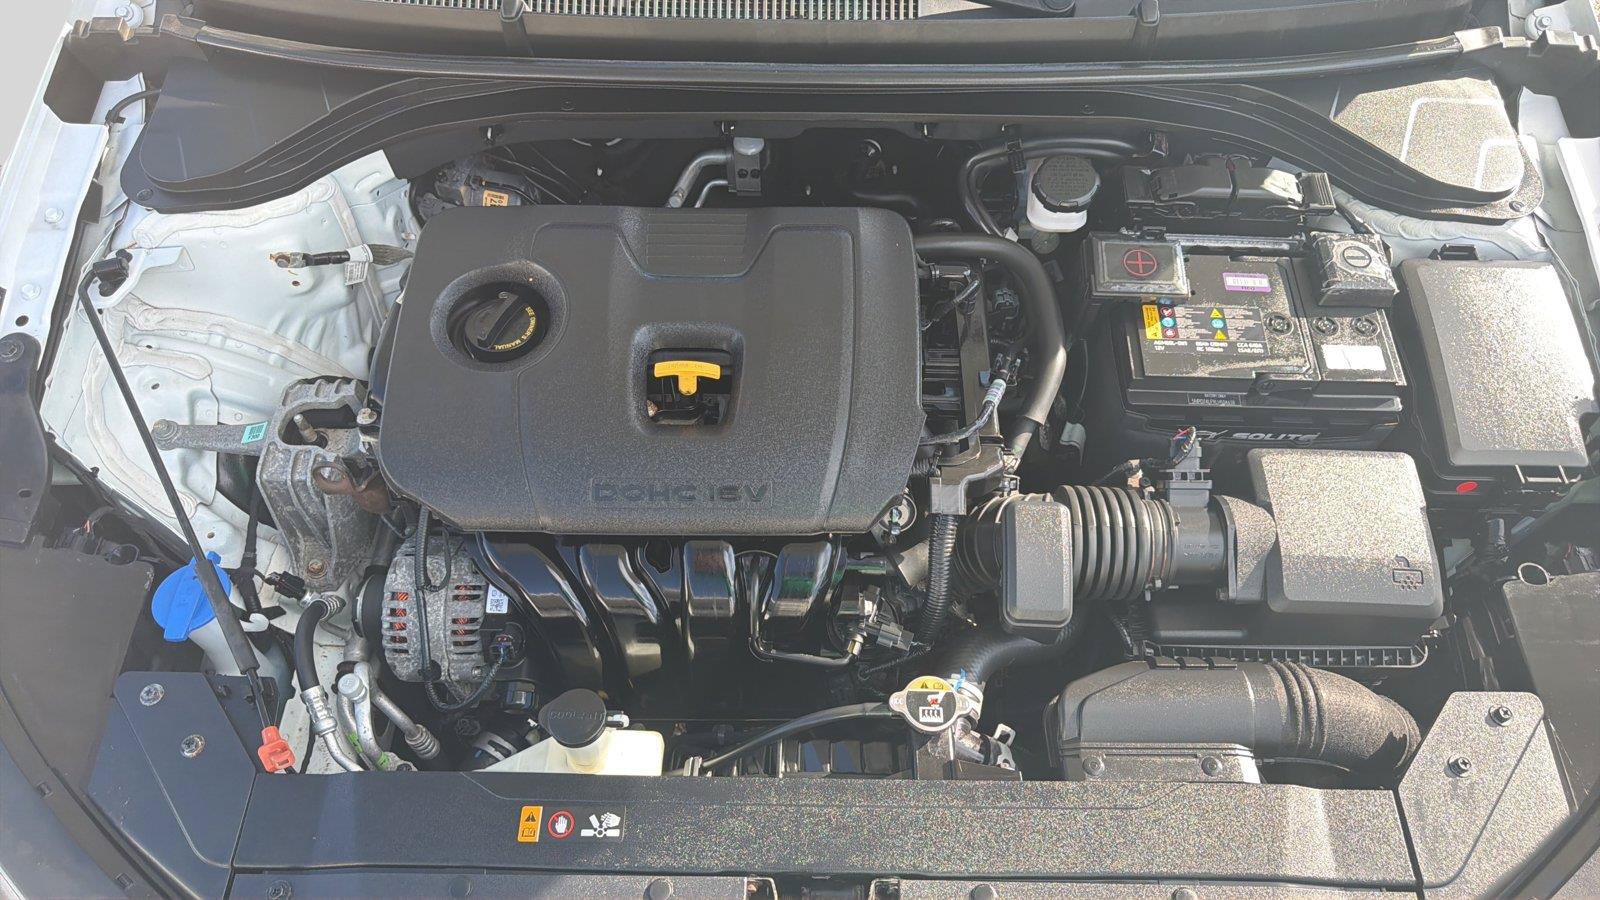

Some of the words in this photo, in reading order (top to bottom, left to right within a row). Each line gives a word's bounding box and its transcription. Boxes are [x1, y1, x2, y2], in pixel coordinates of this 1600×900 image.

[525, 306, 535, 316] SEE
[494, 339, 522, 350] MANUAL
[593, 484, 697, 501] DOHC
